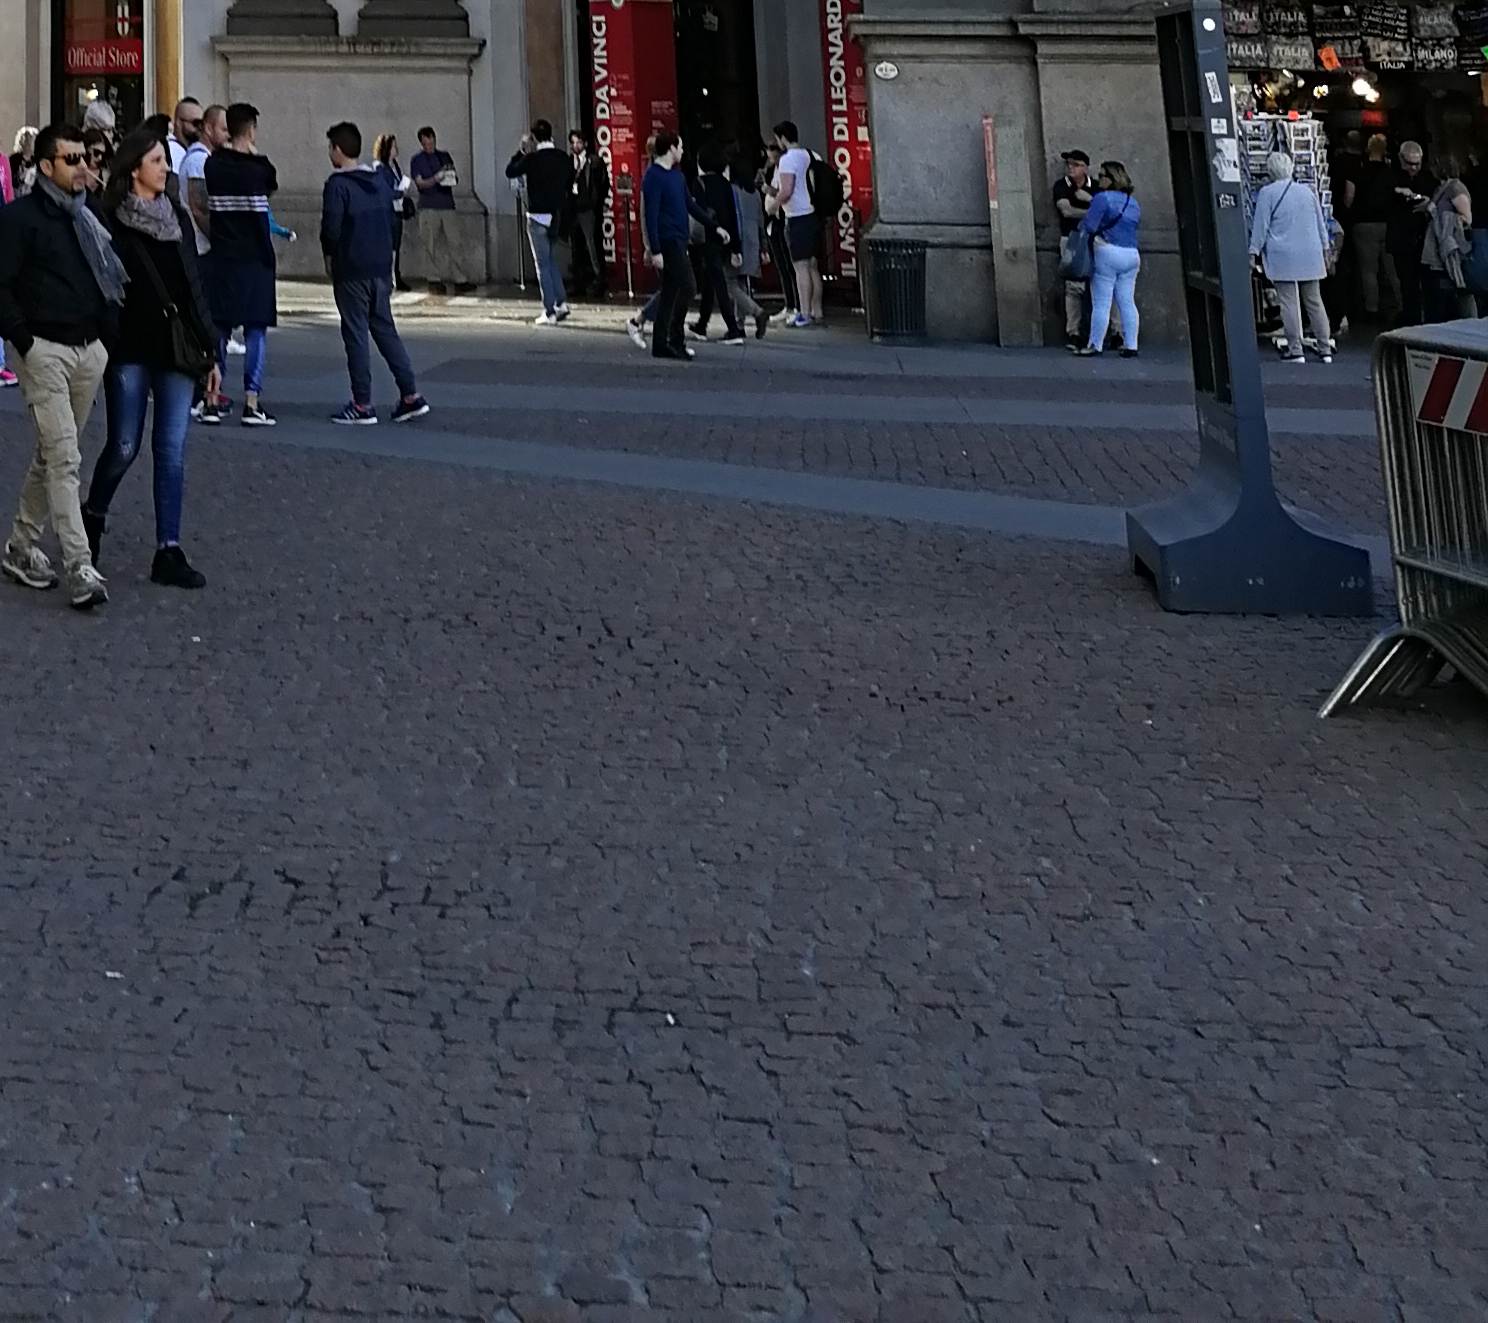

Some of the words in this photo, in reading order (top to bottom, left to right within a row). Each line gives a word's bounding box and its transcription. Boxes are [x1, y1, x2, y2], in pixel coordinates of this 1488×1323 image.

[67, 46, 106, 68] Official
[108, 47, 139, 68] Store
[592, 15, 608, 83] VINCI
[1227, 43, 1263, 57] ITALIA
[1417, 48, 1455, 60] MILANO
[1379, 61, 1406, 70] ITALIA
[595, 84, 610, 120] DA
[832, 116, 850, 142] DI
[841, 257, 857, 278] IL
